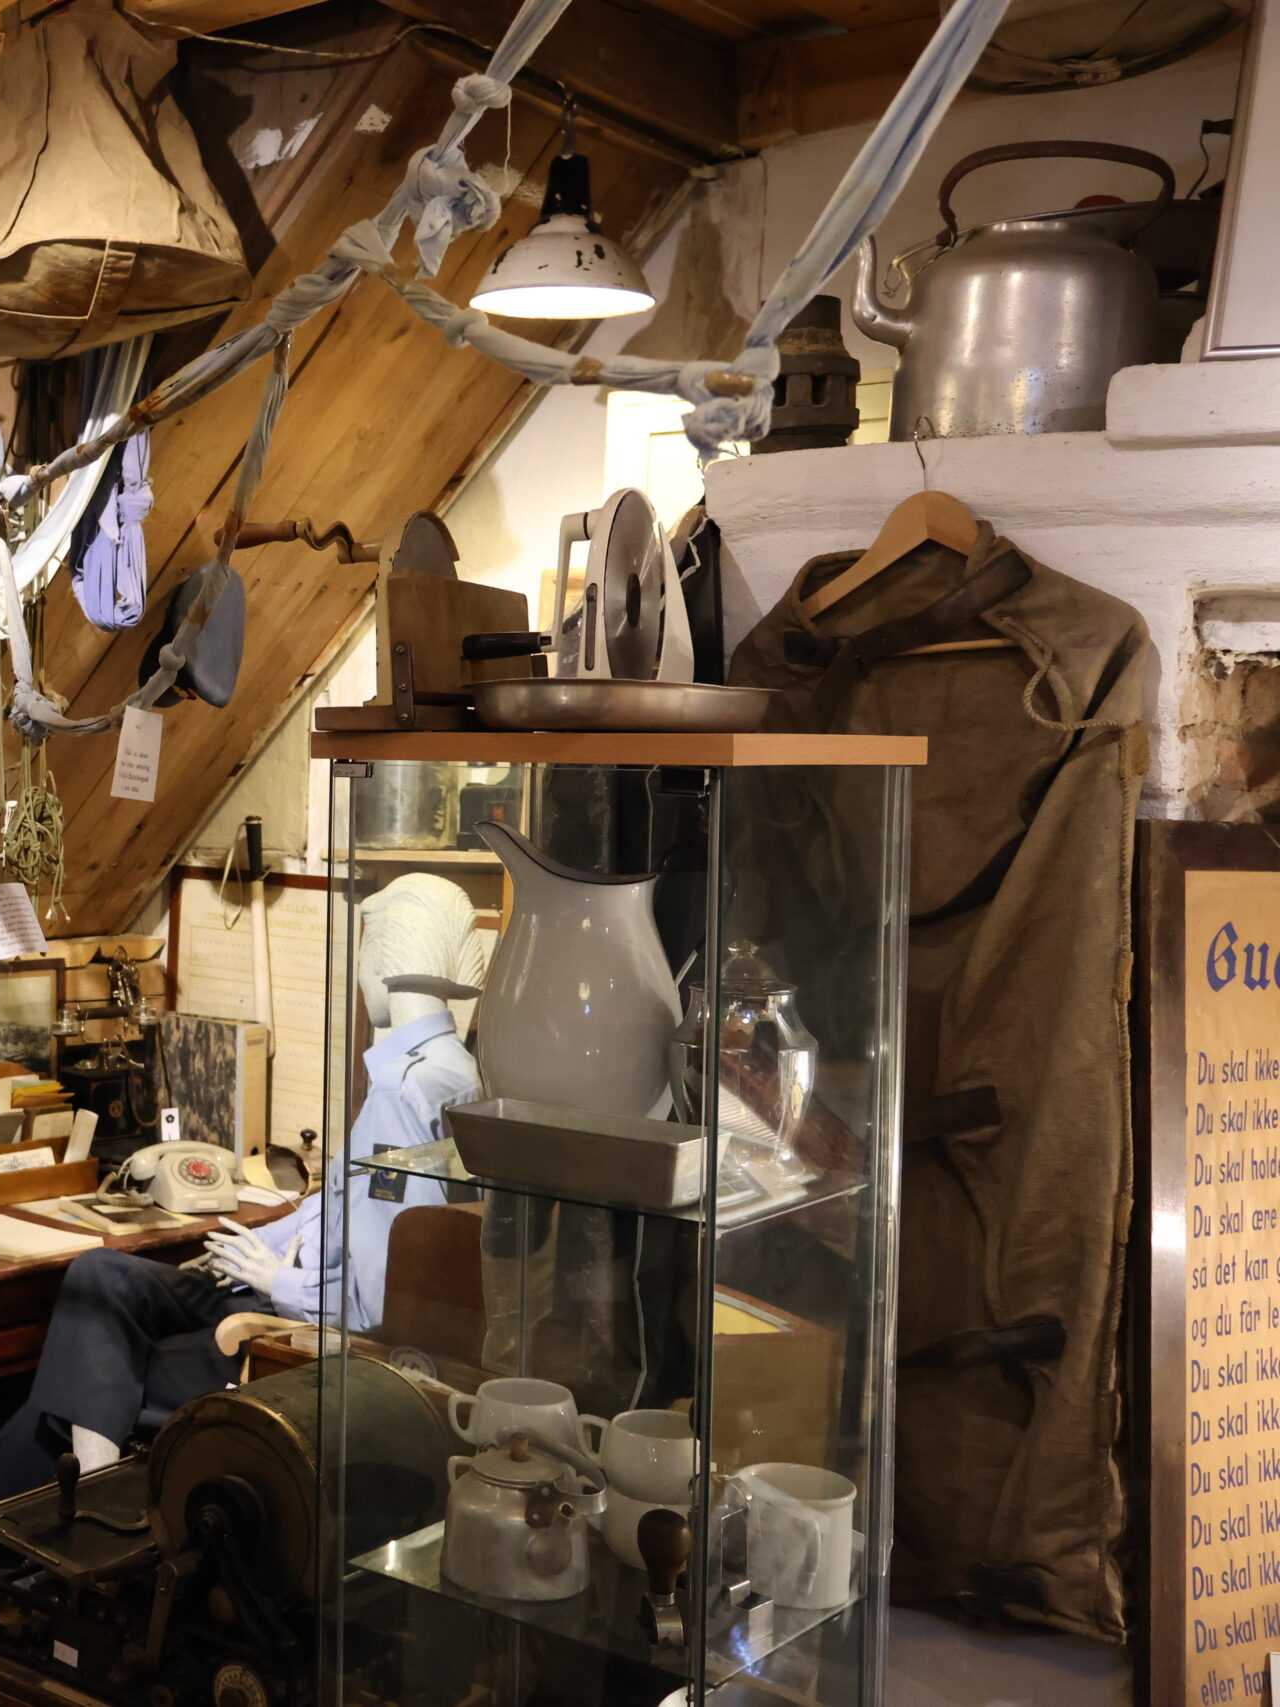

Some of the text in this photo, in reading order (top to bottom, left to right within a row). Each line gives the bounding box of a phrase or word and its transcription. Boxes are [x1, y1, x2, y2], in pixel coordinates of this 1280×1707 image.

[1206, 920, 1280, 993] Gu
[1198, 1048, 1279, 1086] Du skal ikke
[1196, 1098, 1279, 1136] Du skal ikke
[1194, 1146, 1280, 1187] Du skal hold
[1193, 1199, 1277, 1238] Du skal ære
[1191, 1257, 1207, 1290] så
[1215, 1252, 1237, 1285] det
[1244, 1249, 1269, 1282] kan
[1191, 1317, 1208, 1348] og
[1215, 1303, 1232, 1337] du
[1240, 1299, 1261, 1334] får
[1191, 1347, 1280, 1393] Du skal ikk
[1191, 1411, 1211, 1445] Du
[1217, 1402, 1249, 1440] skal
[1191, 1462, 1211, 1497] Du
[1218, 1452, 1249, 1490] skal
[1191, 1514, 1212, 1549] Du
[1220, 1503, 1251, 1542] skal
[1192, 1566, 1214, 1601] Du
[1221, 1555, 1252, 1594] skal
[1194, 1619, 1218, 1654] Du
[1224, 1607, 1257, 1648] skal
[1200, 1669, 1236, 1706] eller
